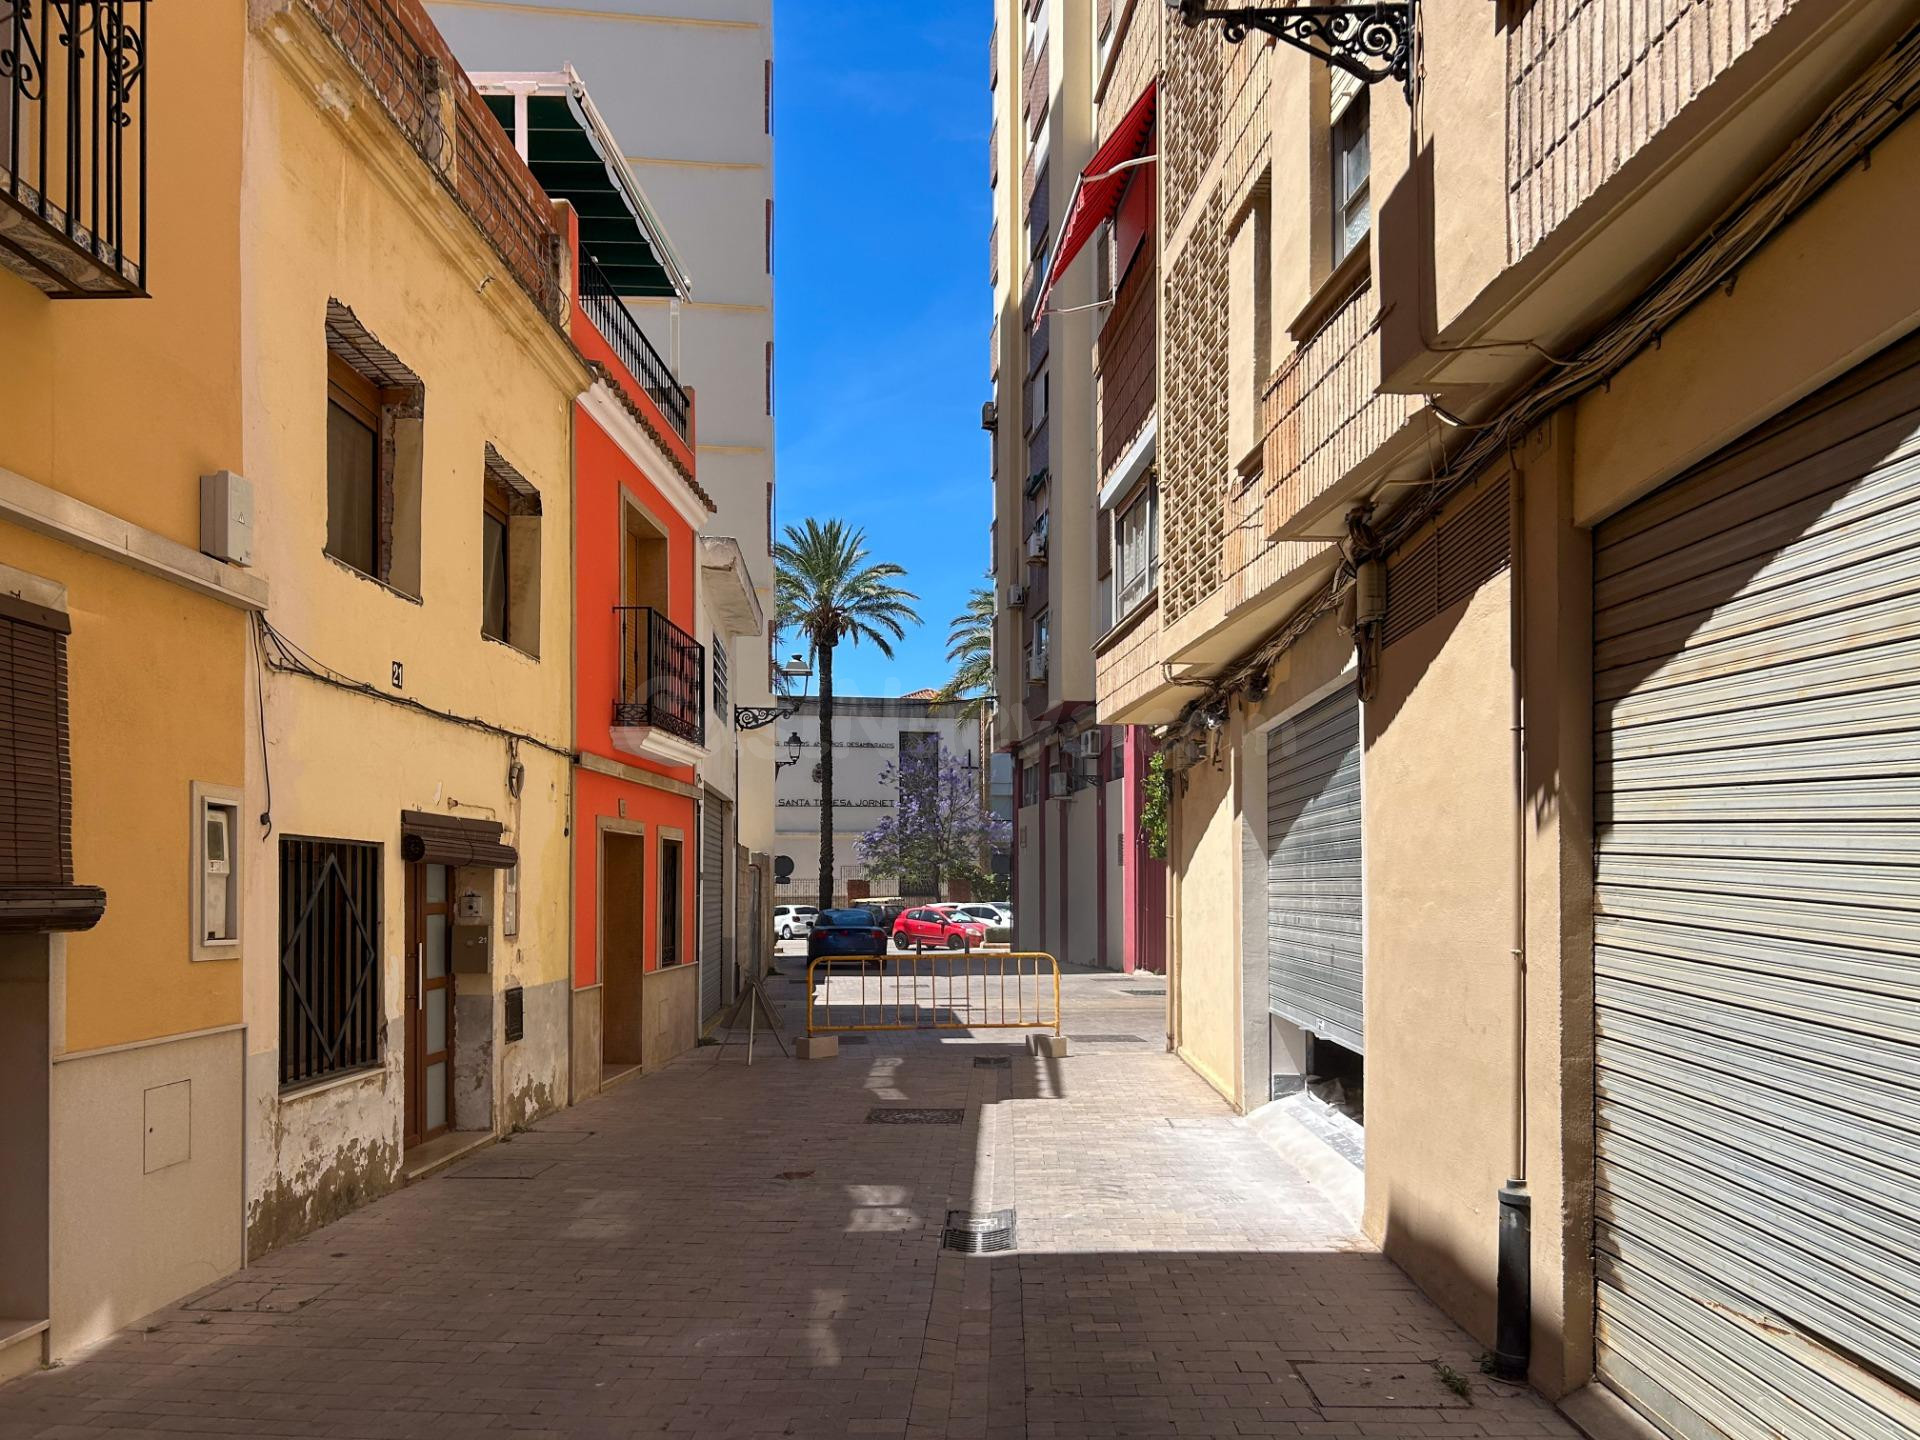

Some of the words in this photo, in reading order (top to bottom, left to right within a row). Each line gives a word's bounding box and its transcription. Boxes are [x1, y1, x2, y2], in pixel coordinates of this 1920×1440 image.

[393, 664, 402, 686] 21
[778, 799, 810, 807] SANTA
[855, 799, 896, 807] JORNET
[478, 936, 488, 944] 21
